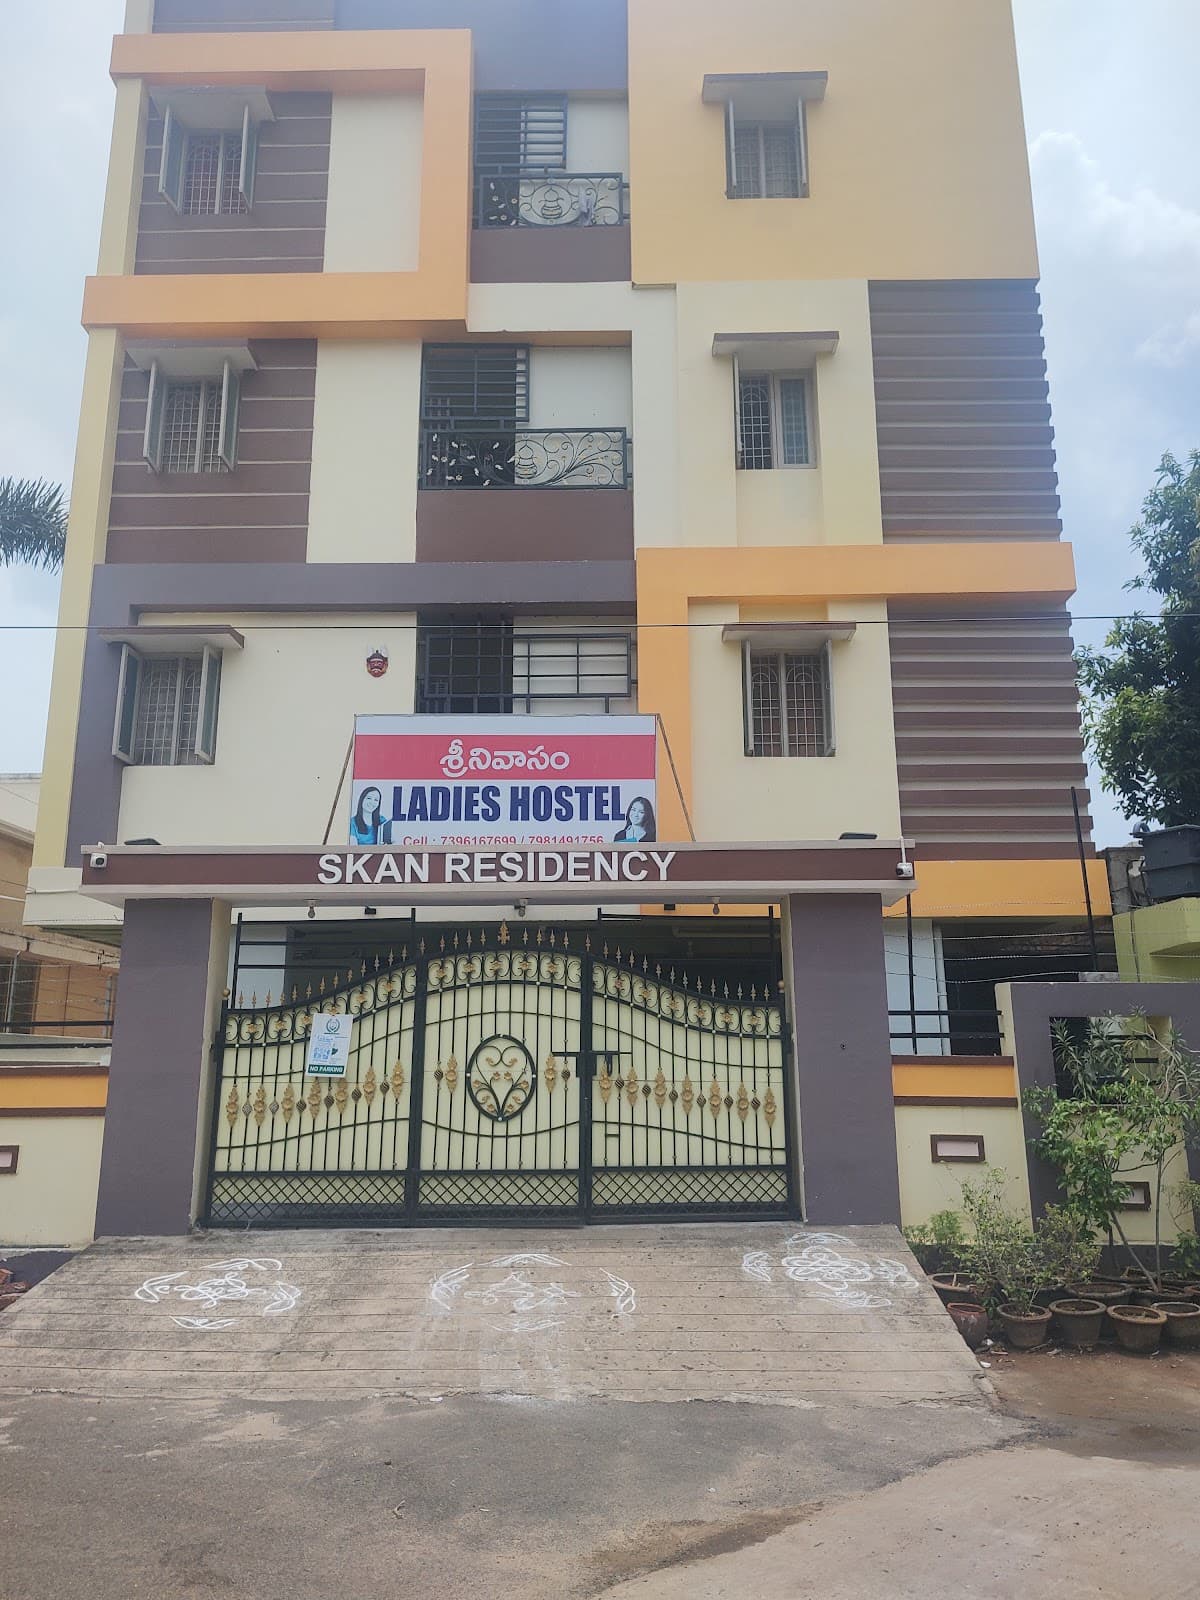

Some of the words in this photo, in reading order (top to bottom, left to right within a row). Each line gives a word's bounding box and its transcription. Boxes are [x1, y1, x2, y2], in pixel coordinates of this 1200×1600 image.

[439, 738, 570, 779] శ్రీనివాసం
[391, 785, 501, 822] LADIES
[509, 785, 626, 821] HOSTEL
[403, 835, 428, 846] Cell
[317, 852, 429, 884] SKAN
[444, 850, 677, 883] RESIDENCY
